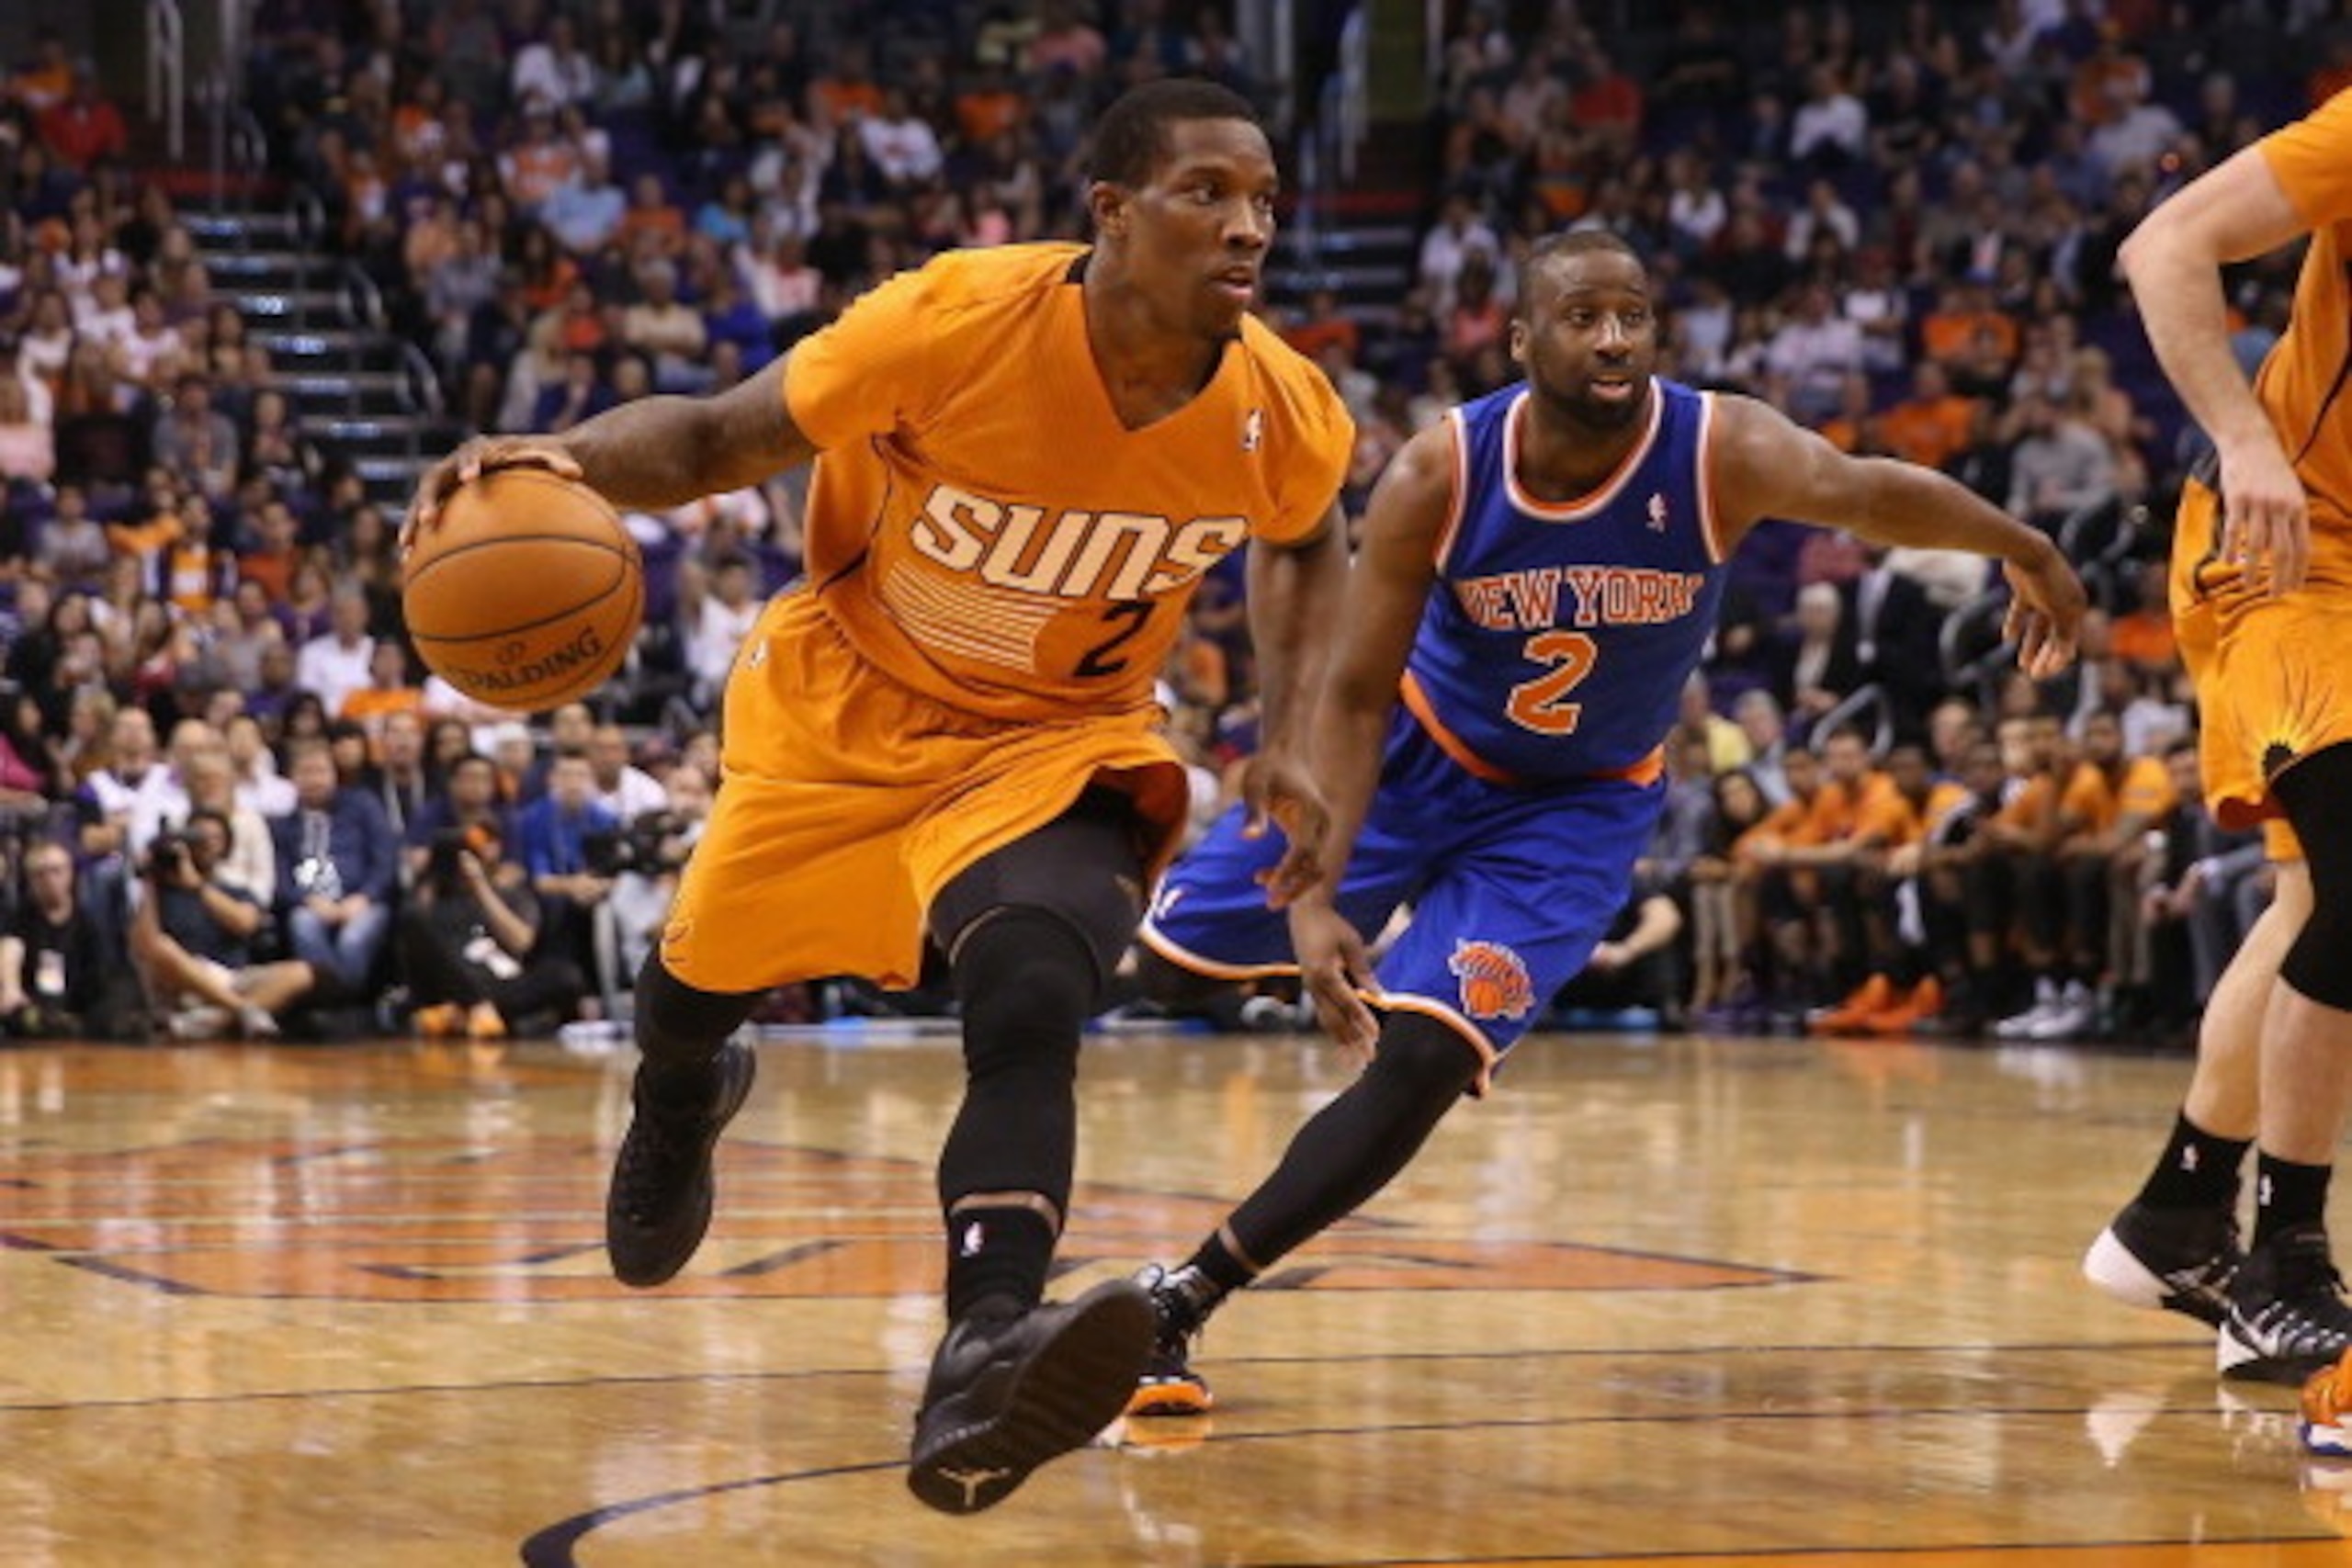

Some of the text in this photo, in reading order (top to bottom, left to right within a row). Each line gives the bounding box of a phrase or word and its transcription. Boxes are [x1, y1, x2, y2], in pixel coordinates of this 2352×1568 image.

[1566, 565, 1703, 627] YORK
[445, 626, 601, 690] PALDING
[1073, 601, 1157, 676] 2
[1505, 630, 1598, 734] 2
